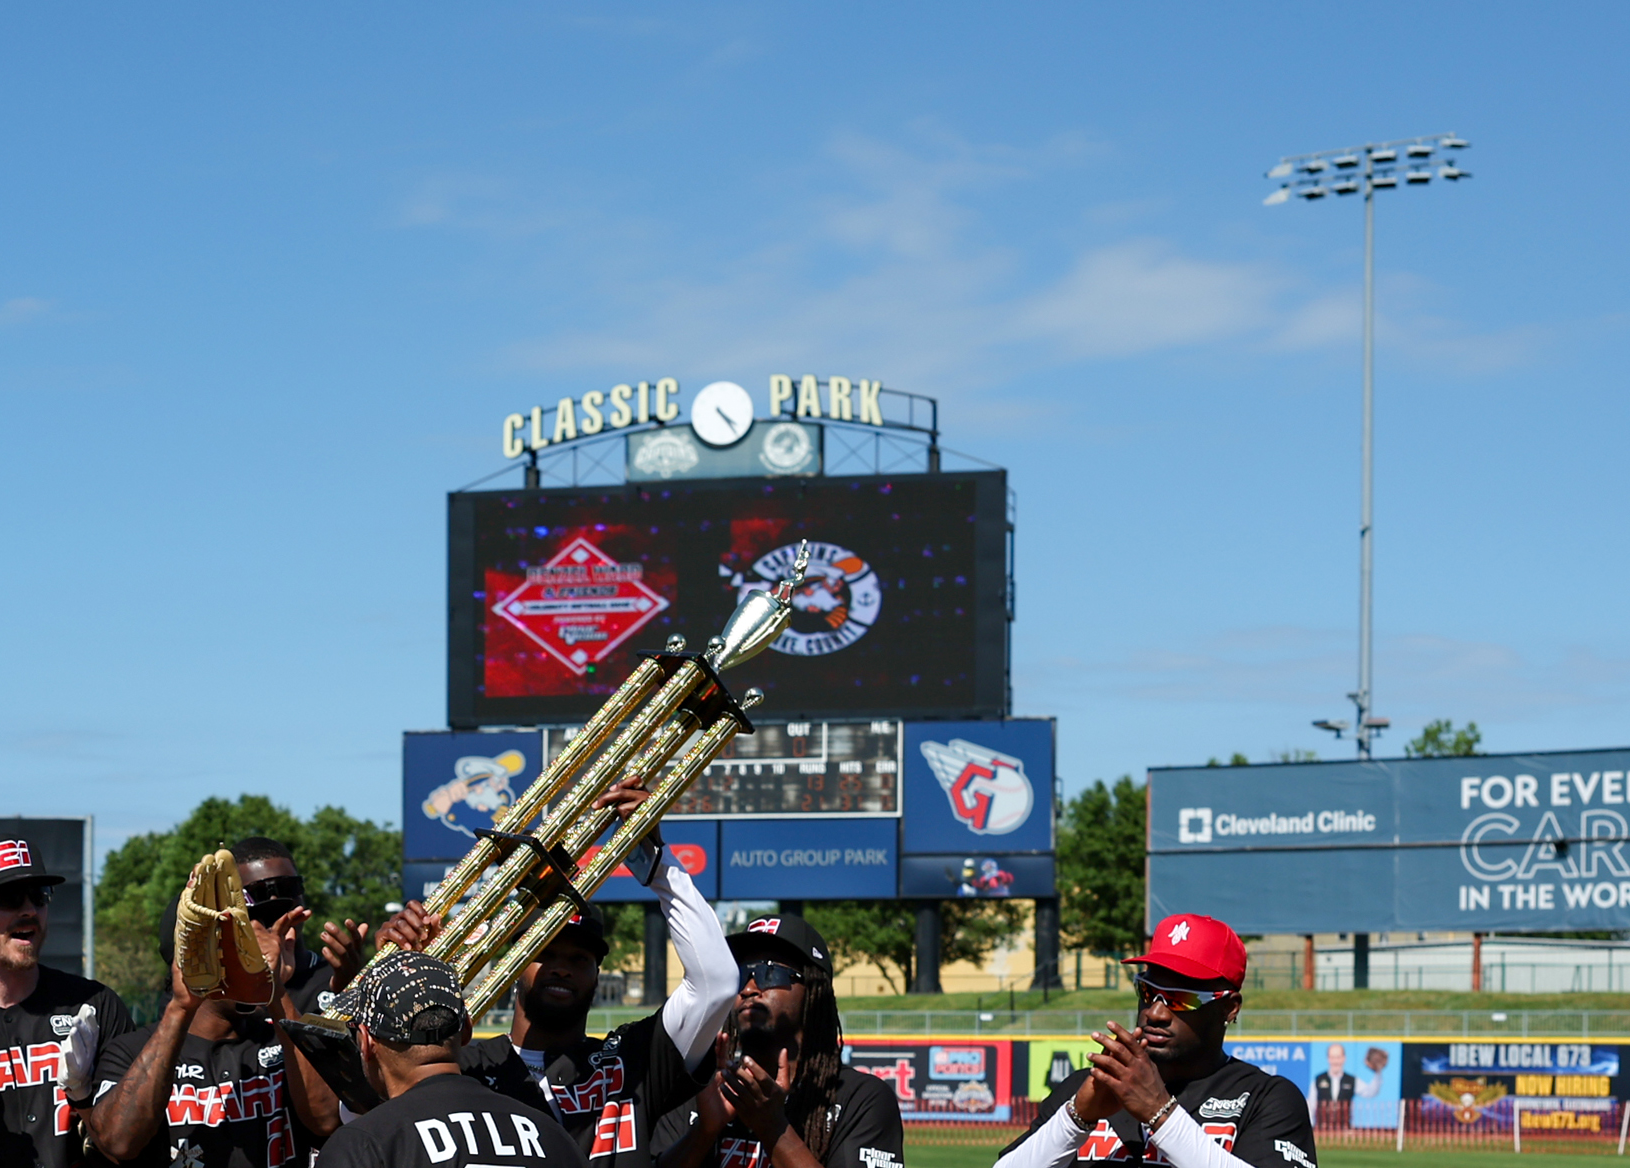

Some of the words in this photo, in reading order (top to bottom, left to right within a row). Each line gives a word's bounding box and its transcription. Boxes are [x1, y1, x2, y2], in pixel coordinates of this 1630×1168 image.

[503, 377, 679, 458] CLASSIC
[770, 374, 883, 426] PARK
[787, 722, 811, 737] OUT
[1461, 776, 1540, 810] FOR
[1550, 771, 1630, 806] EVE
[1215, 813, 1314, 836] Cleveland
[1317, 810, 1376, 834] Clinic
[730, 849, 778, 868] AUTO
[780, 847, 840, 866] GROUP
[844, 846, 888, 865] PARK
[1459, 885, 1489, 911] IN
[1497, 884, 1555, 909] THE
[1232, 1046, 1289, 1061] CATCH
[1292, 1047, 1306, 1061] A
[1449, 1044, 1496, 1067] IBEW
[1498, 1044, 1553, 1067] LOCAL
[1556, 1044, 1592, 1067] 673
[175, 1064, 205, 1079] TLR
[1515, 1075, 1554, 1096] NOW
[1555, 1075, 1611, 1096] HIRING
[415, 1111, 546, 1164] DTLR
